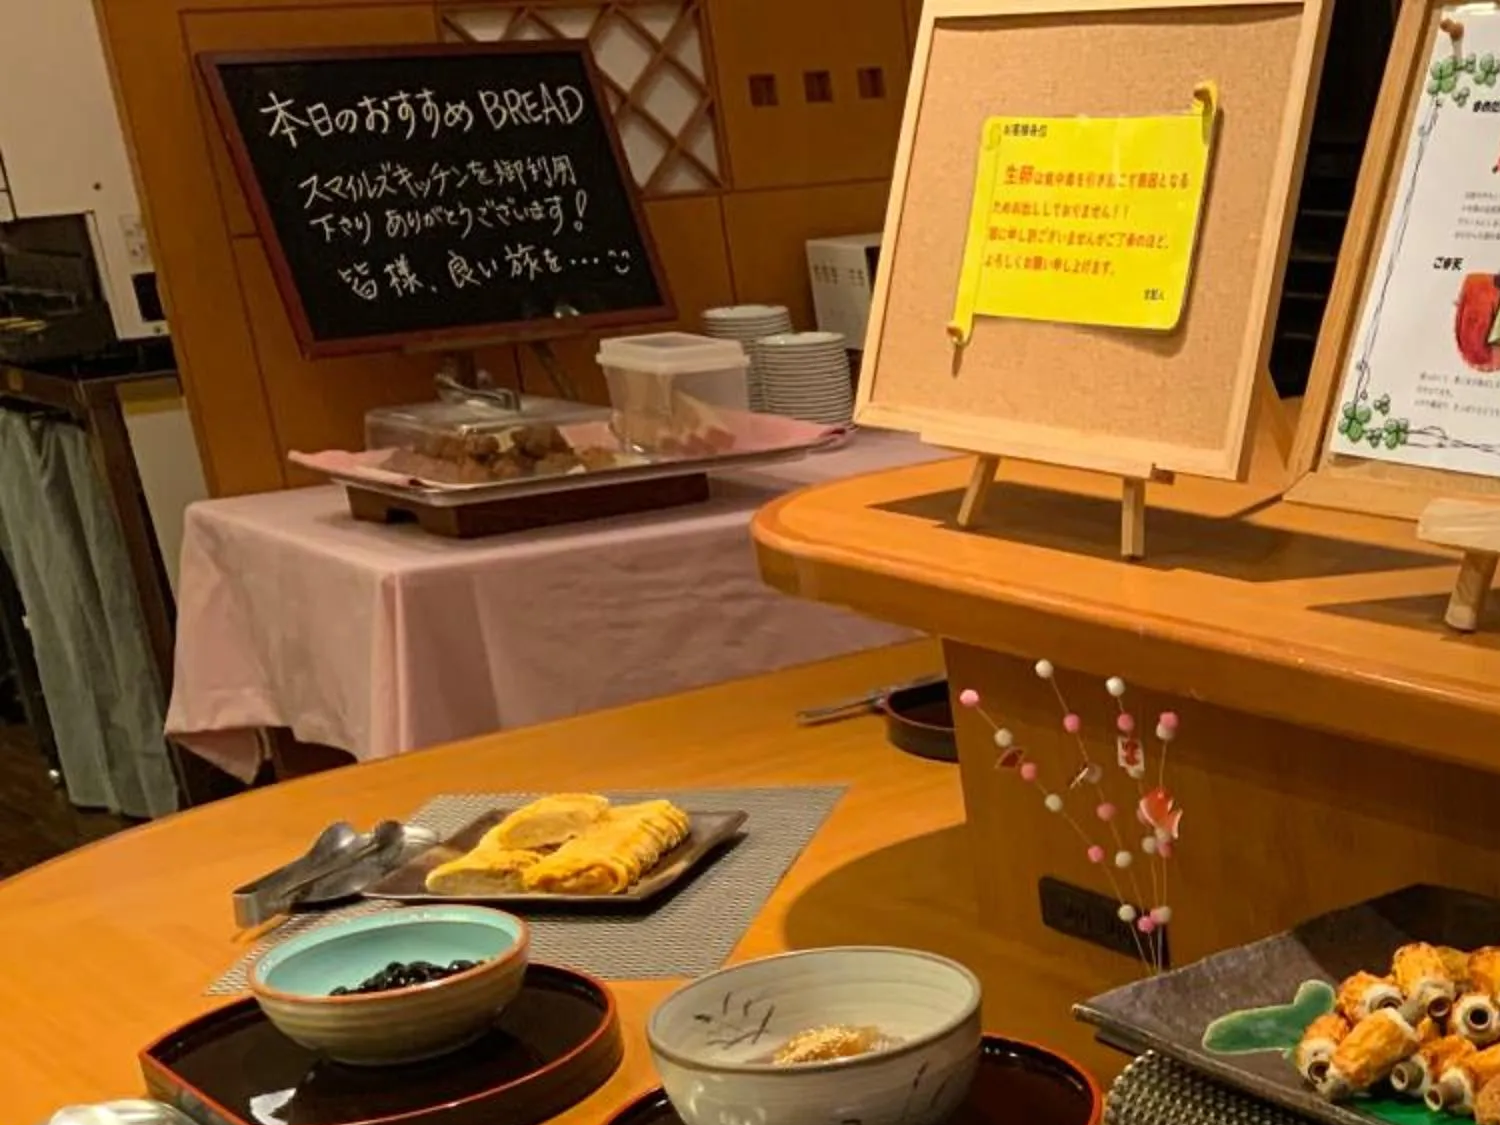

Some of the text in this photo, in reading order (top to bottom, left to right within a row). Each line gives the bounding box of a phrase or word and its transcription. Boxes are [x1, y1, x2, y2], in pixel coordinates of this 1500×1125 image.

[259, 82, 584, 148] 本日のおすすめ BREAD
[298, 153, 577, 209] スマイルズキッチンを御利用
[309, 213, 372, 245] 下さり
